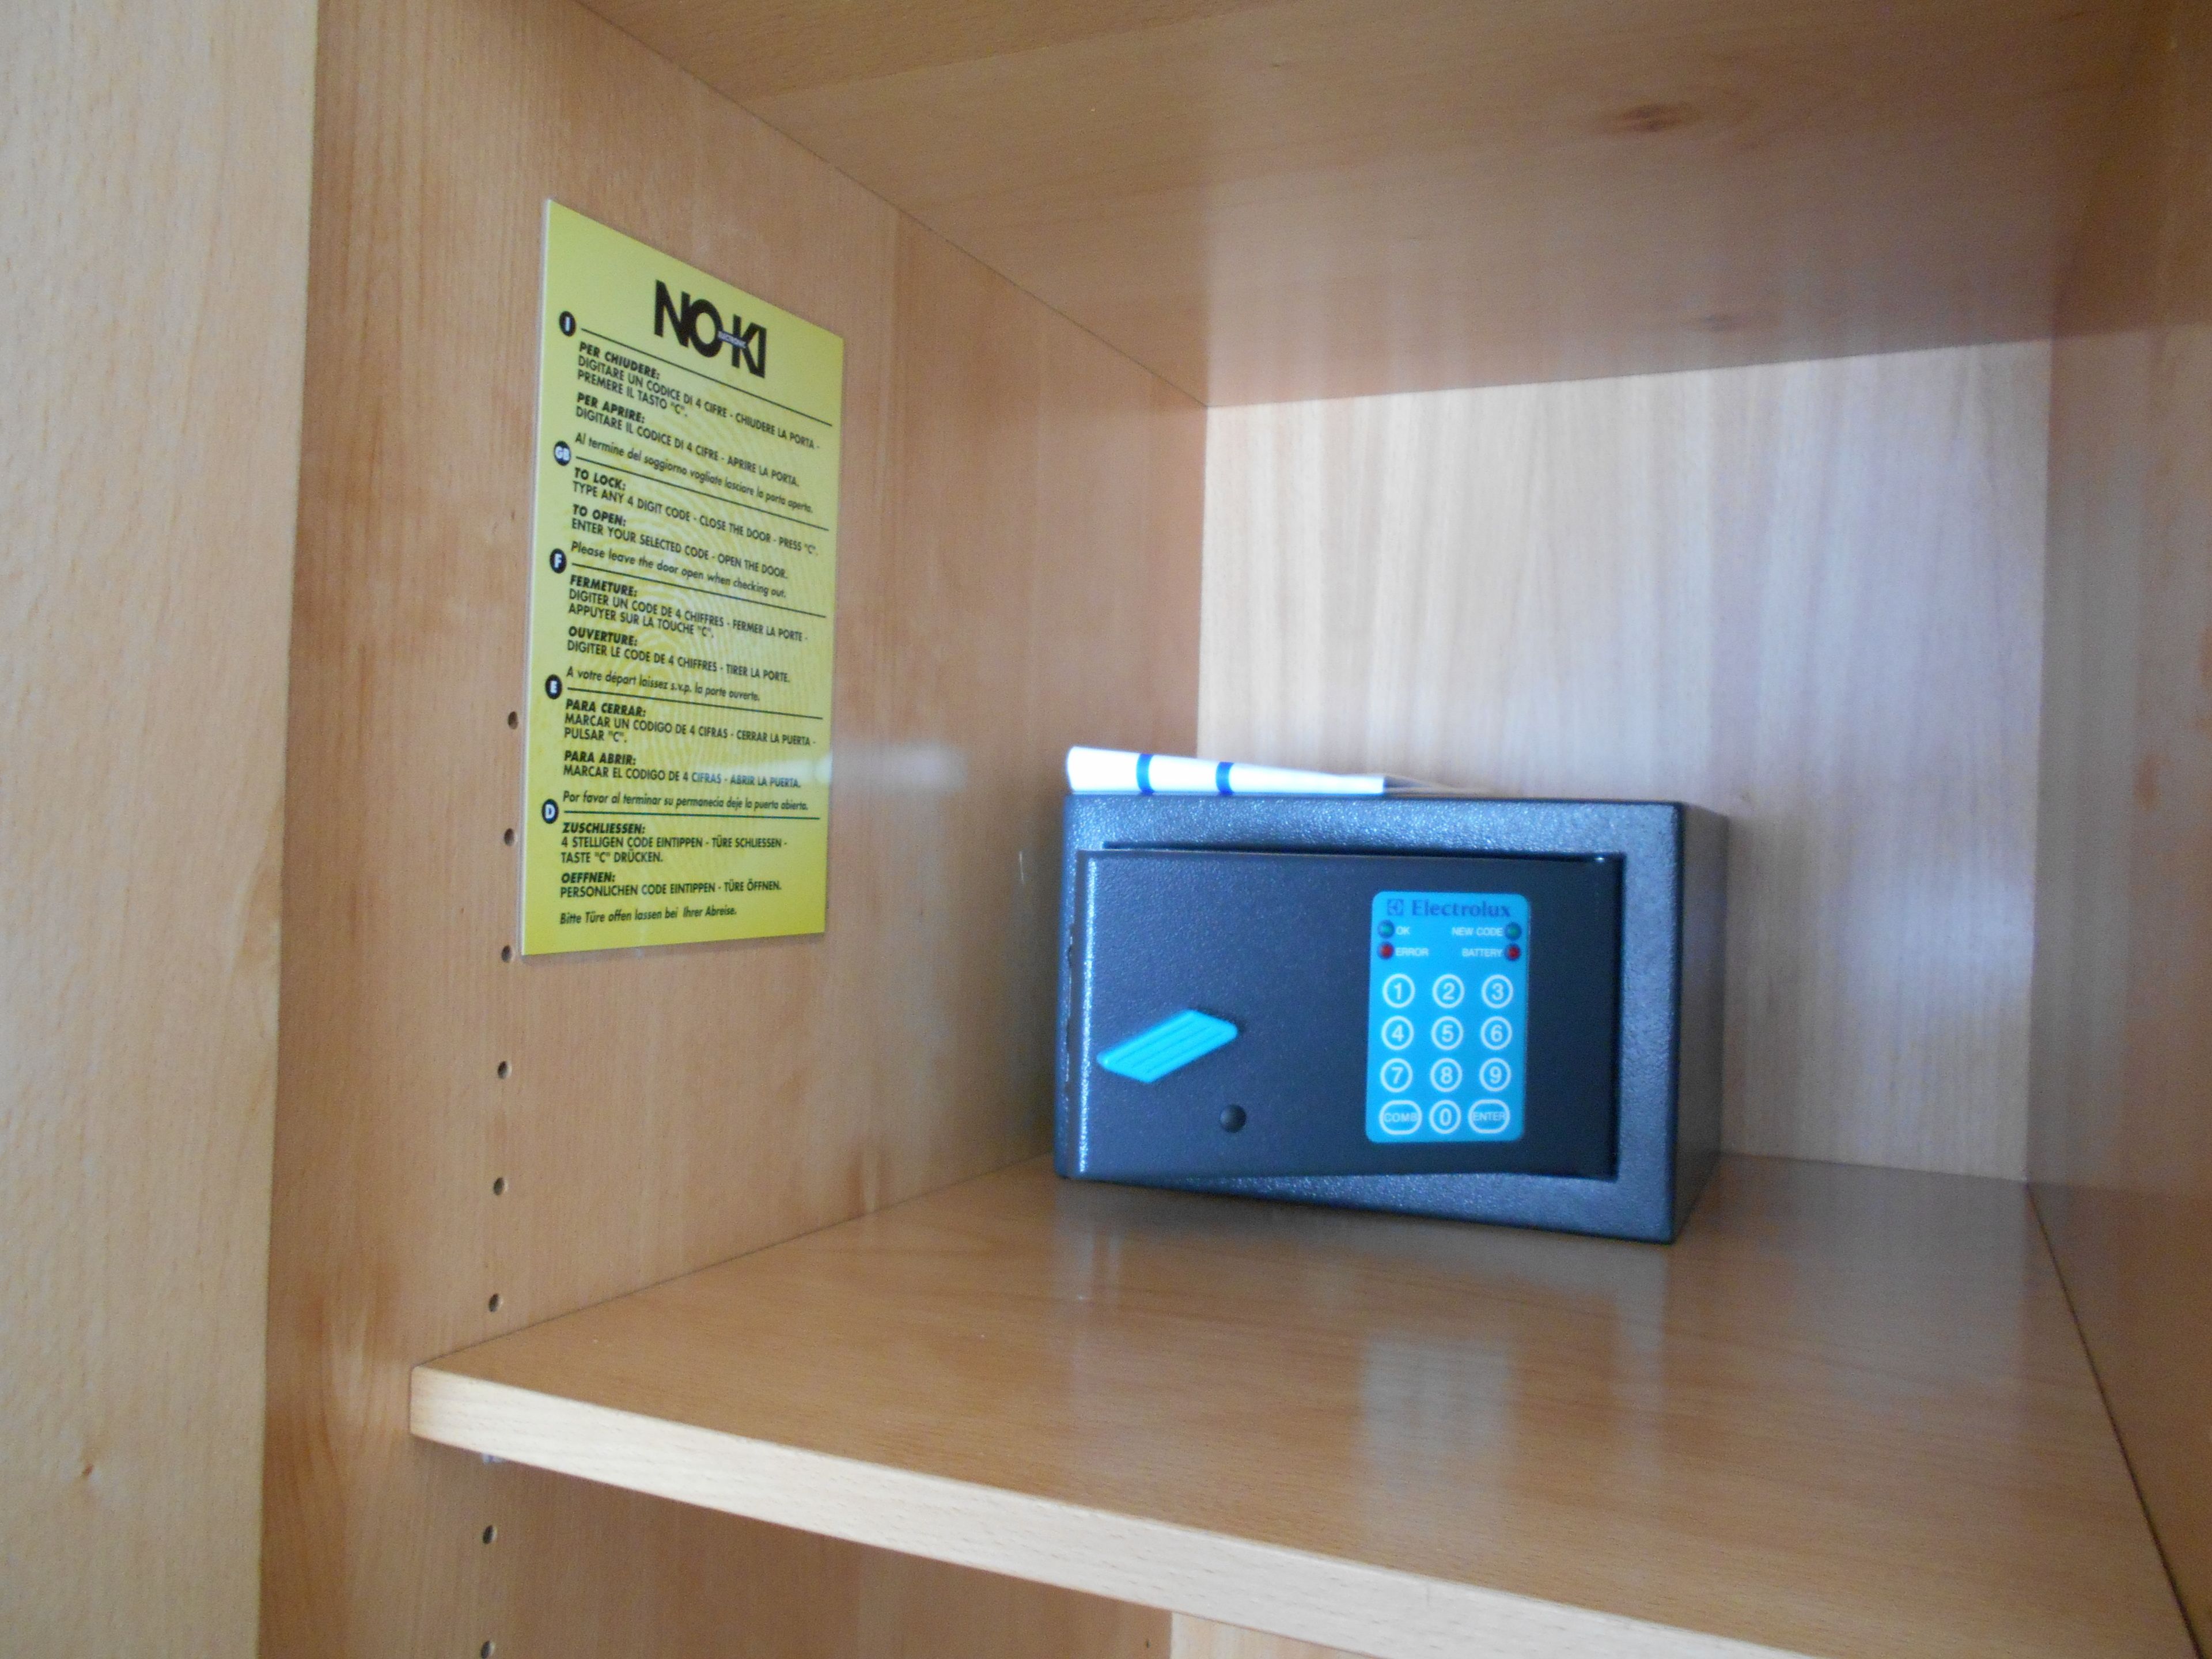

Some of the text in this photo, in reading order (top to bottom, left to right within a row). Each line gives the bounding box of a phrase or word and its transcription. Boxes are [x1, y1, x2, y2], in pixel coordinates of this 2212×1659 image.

[564, 315, 570, 333] I
[579, 340, 660, 380] PER CHIUDERE:
[577, 368, 623, 395] PREMERE
[626, 385, 634, 399] IL
[637, 389, 667, 410] TASTO
[578, 355, 727, 418] DIGITARE UN CODICE DI 4 CIFRE
[577, 391, 645, 424] PER APRIRE:
[575, 406, 718, 461] DIGITARE IL CODICE DI 4 CIFRE
[554, 444, 570, 462] GB
[575, 431, 687, 479] Al termine del soggiorno
[574, 467, 626, 491] TO LOCK:
[572, 480, 801, 551] TYPE ANY 4 DIGIT CODE CLOSE THE DOOR PRESS
[573, 503, 626, 527] TO OPEN:
[571, 517, 787, 579] ENTER YOUR SELECTED CODE OPEN THE DOOR.
[553, 552, 563, 569] F
[571, 540, 605, 559] Please
[608, 548, 635, 565] leave
[638, 555, 654, 569] the
[656, 559, 678, 574] door
[681, 568, 703, 583] open
[706, 570, 730, 586] when
[733, 576, 769, 597] checking
[570, 574, 637, 597] FERMETURE:
[568, 602, 616, 621] APPUYER
[620, 611, 639, 625] SUR
[642, 615, 654, 628] LA
[657, 618, 694, 635] TOUCHE
[569, 588, 802, 642] DIGITER UN CODE DE 4 CHIFFRES FERMER LA PORTE
[568, 625, 637, 646] OUVERTURE:
[567, 639, 717, 672] DIGITER LE CODE DE 4 CHIFFRES
[566, 665, 574, 677] A
[577, 666, 602, 681] votre
[604, 671, 636, 688] départ
[638, 675, 668, 690] laissez
[550, 680, 558, 694] E
[566, 698, 646, 718] PARA CERRAR:
[564, 726, 604, 741] PULSAR
[565, 712, 767, 742] MARCAR UN CODIGO DE 4 CIFRAS CERRAR
[564, 749, 636, 765] PARA ABRIR:
[563, 763, 721, 783] MARCAR EL CODIGO DE 4 CIFRAS
[562, 790, 673, 806] Por favor al terminar su
[544, 803, 556, 820] D
[562, 822, 645, 834] ZUSCHLIESSEN:
[561, 834, 781, 848] 4 STELLIGEN CODE EINTIPPEN TÜRE SCHLIESSEN
[560, 851, 590, 862] TASTE
[613, 848, 663, 862] DRÜCKEN.
[560, 872, 615, 883] OEFFNEN:
[641, 883, 666, 895] CODE
[670, 882, 715, 894] EINTIPPEN
[724, 878, 744, 892] TÜRE
[747, 877, 782, 892] ÖFFNEN.
[559, 911, 581, 925] Bitte
[585, 911, 605, 923] Türe
[608, 910, 631, 922] offen
[634, 908, 662, 921] lassen
[664, 907, 677, 919] bei
[683, 906, 702, 918] Ihrer
[1411, 899, 1510, 918] Electrolux
[1396, 927, 1410, 935] OK
[1452, 927, 1502, 937] NEW CODE
[1395, 948, 1429, 957] ERROR
[1461, 948, 1502, 957] BATTERY
[1393, 983, 1402, 1000] 1
[1442, 983, 1455, 1001] 2
[1492, 983, 1505, 1001] 3
[1392, 1025, 1404, 1041] 4
[1441, 1025, 1453, 1042] 5
[1490, 1025, 1503, 1042] 6
[1392, 1067, 1404, 1084] 7
[1440, 1067, 1453, 1084] 8
[1488, 1067, 1501, 1084] 9
[1384, 1112, 1417, 1123] COMB
[1440, 1108, 1452, 1126] 0
[1472, 1111, 1506, 1122] ENTER
